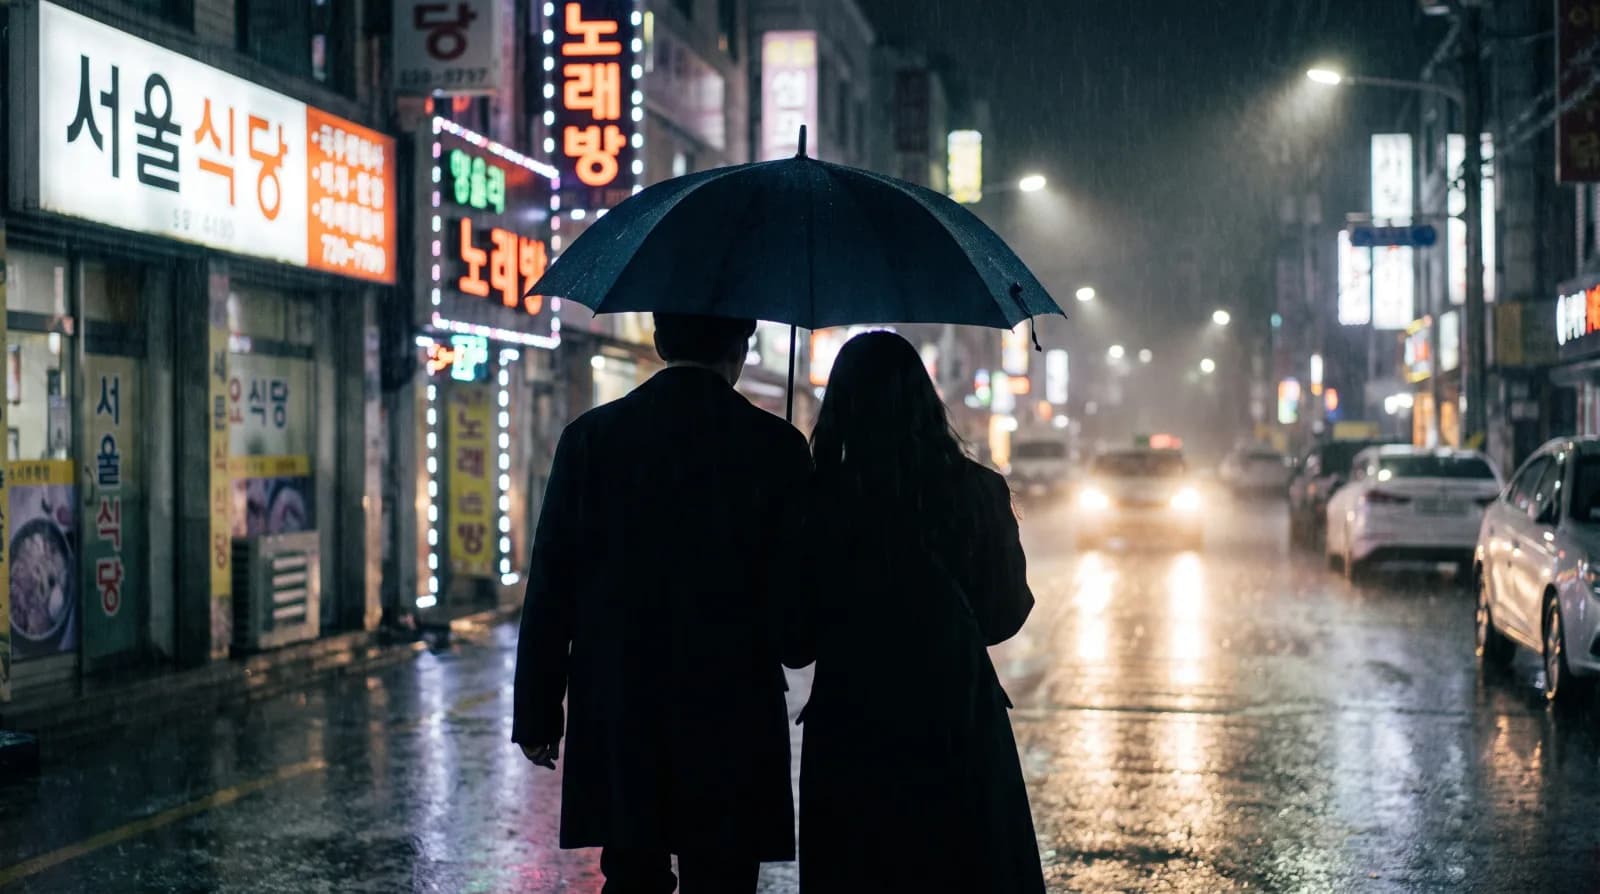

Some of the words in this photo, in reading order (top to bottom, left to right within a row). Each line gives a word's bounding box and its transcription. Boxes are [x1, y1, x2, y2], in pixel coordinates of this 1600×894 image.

[67, 54, 289, 221] 서울식당
[562, 2, 627, 187] 노래방
[97, 376, 124, 616] 서울식당
